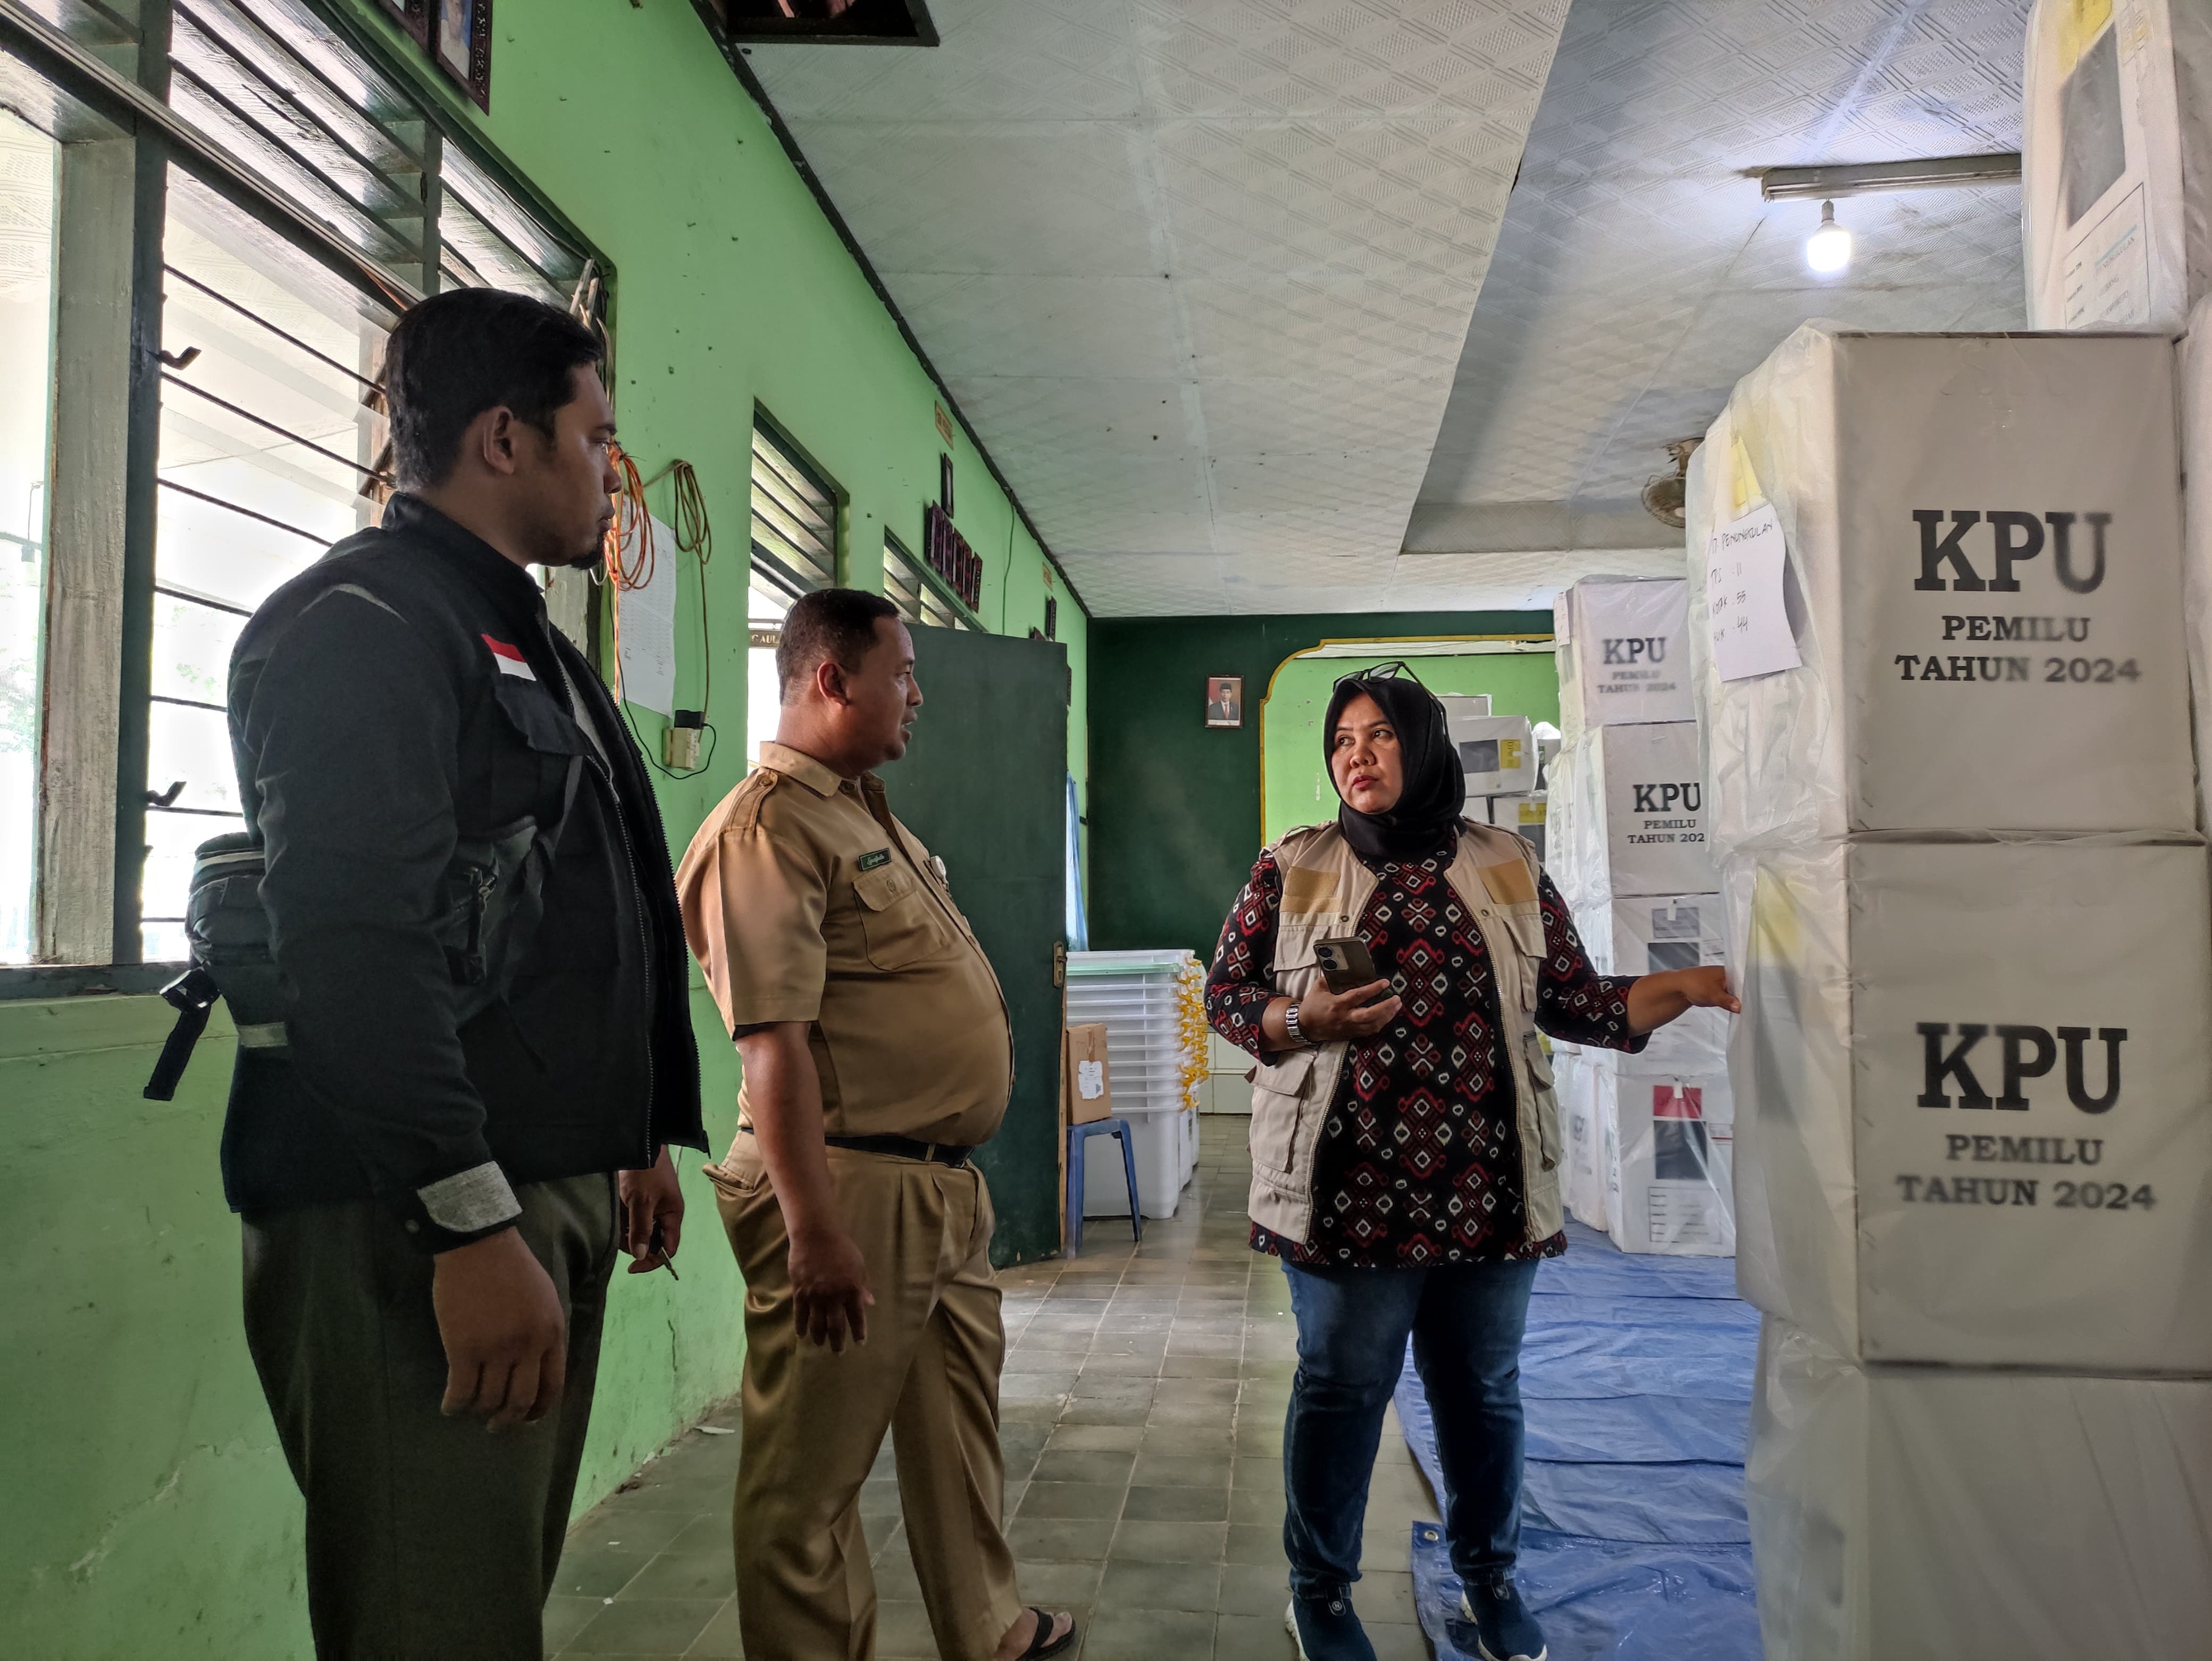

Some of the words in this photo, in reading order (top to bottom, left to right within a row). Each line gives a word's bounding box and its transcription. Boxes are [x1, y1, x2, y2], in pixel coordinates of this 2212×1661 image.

[1912, 509, 2113, 594] KPU
[1941, 615, 2091, 642] PEMILU
[1602, 637, 1666, 664] KPU
[1895, 654, 2030, 681] TAHUN
[2045, 657, 2142, 683] 2024
[1632, 782, 1701, 813] KPU
[1628, 833, 1675, 844] TAHUN
[1680, 833, 1705, 842] 202
[1644, 819, 1697, 829] PEMILU
[1916, 1022, 2127, 1114] KPU
[1946, 1134, 2104, 1165] PEMILU
[1896, 1174, 2040, 1206] TAHUN
[2053, 1181, 2157, 1211] 2024
